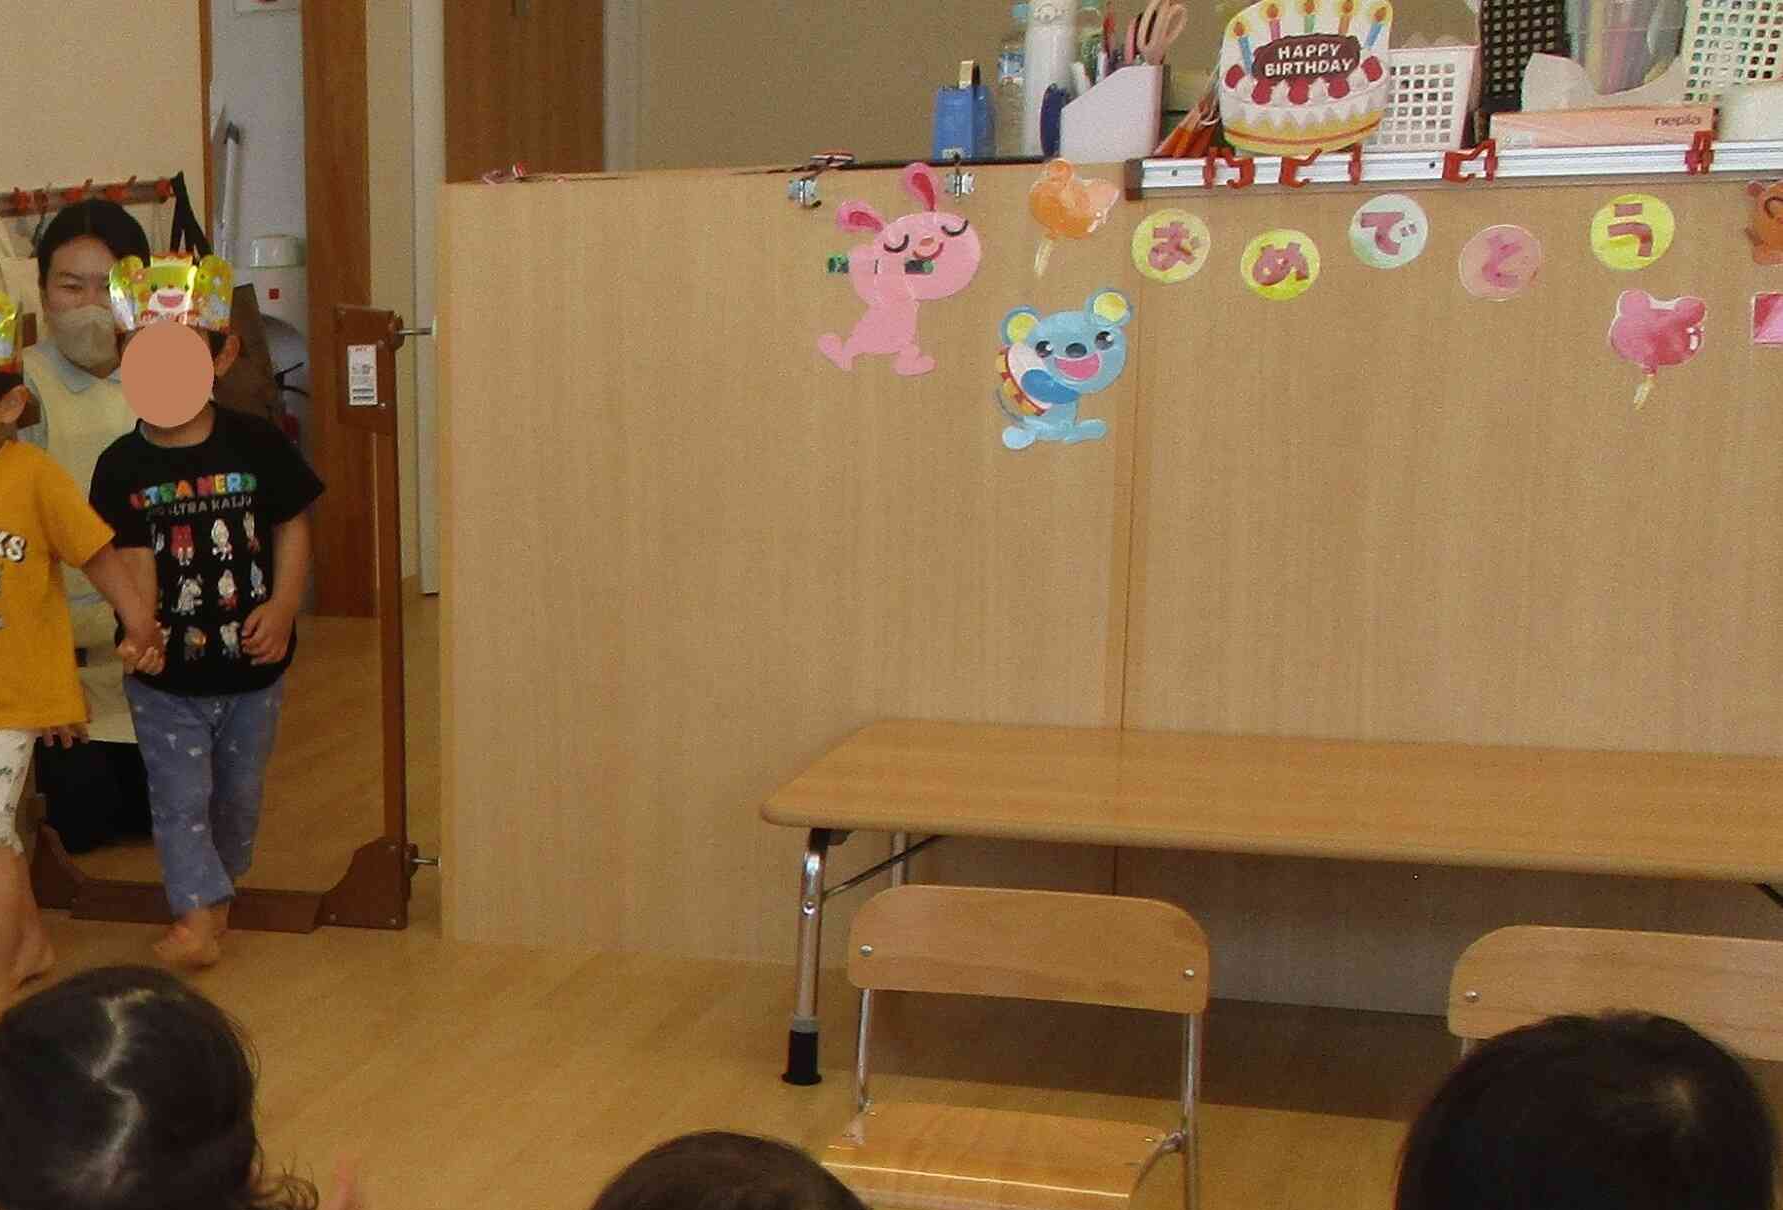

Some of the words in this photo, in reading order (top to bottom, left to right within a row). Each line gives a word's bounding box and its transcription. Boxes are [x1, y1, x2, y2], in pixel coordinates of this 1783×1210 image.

[1278, 43, 1341, 60] HAPPY
[1264, 58, 1354, 77] BIRTHDAY
[1654, 114, 1702, 127] nepia
[1147, 202, 1655, 288] おめでとう
[196, 472, 257, 496] HERO
